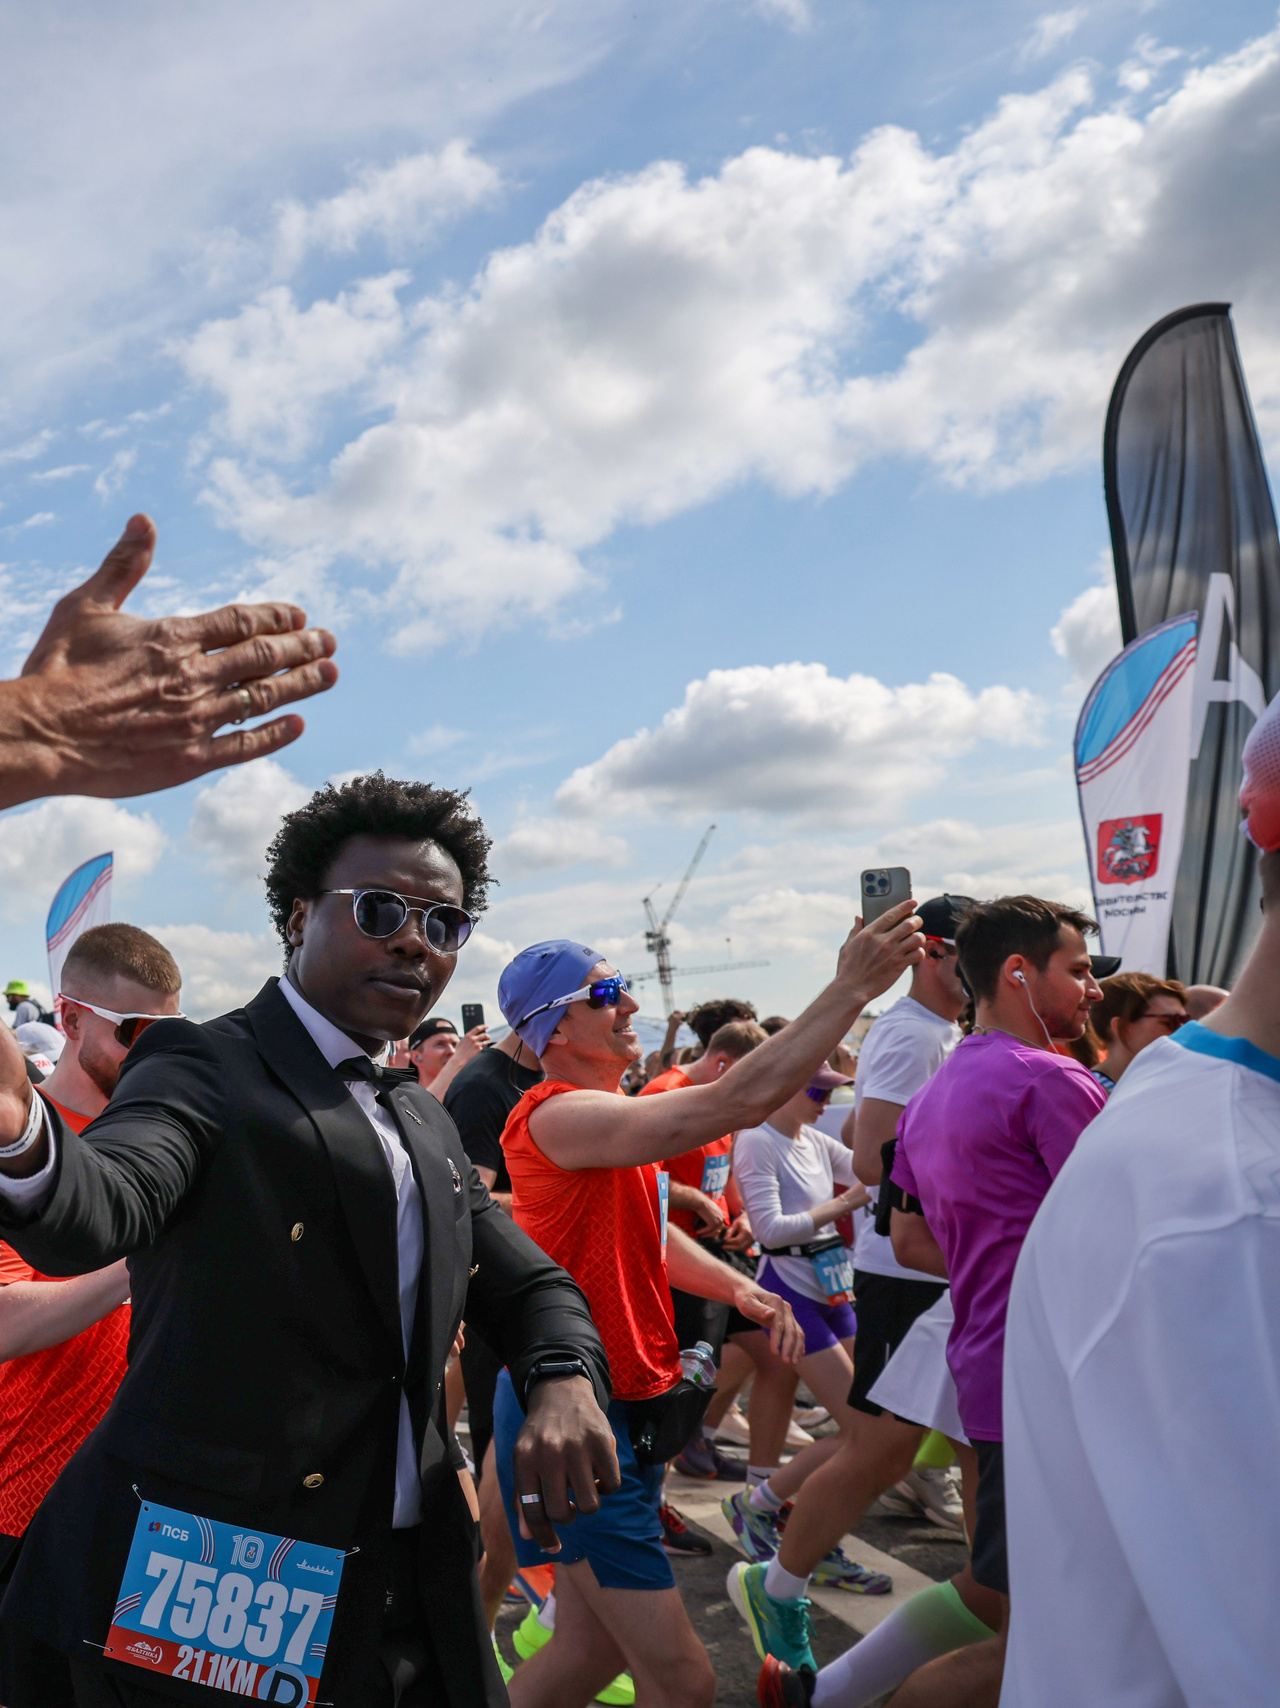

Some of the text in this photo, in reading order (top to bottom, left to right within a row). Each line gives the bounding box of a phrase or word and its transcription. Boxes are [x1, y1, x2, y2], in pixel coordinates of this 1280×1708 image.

[161, 1524, 190, 1542] ПСБ
[230, 1534, 264, 1569] 10
[139, 1550, 325, 1666] 75837
[171, 1644, 259, 1698] 21.1KM
